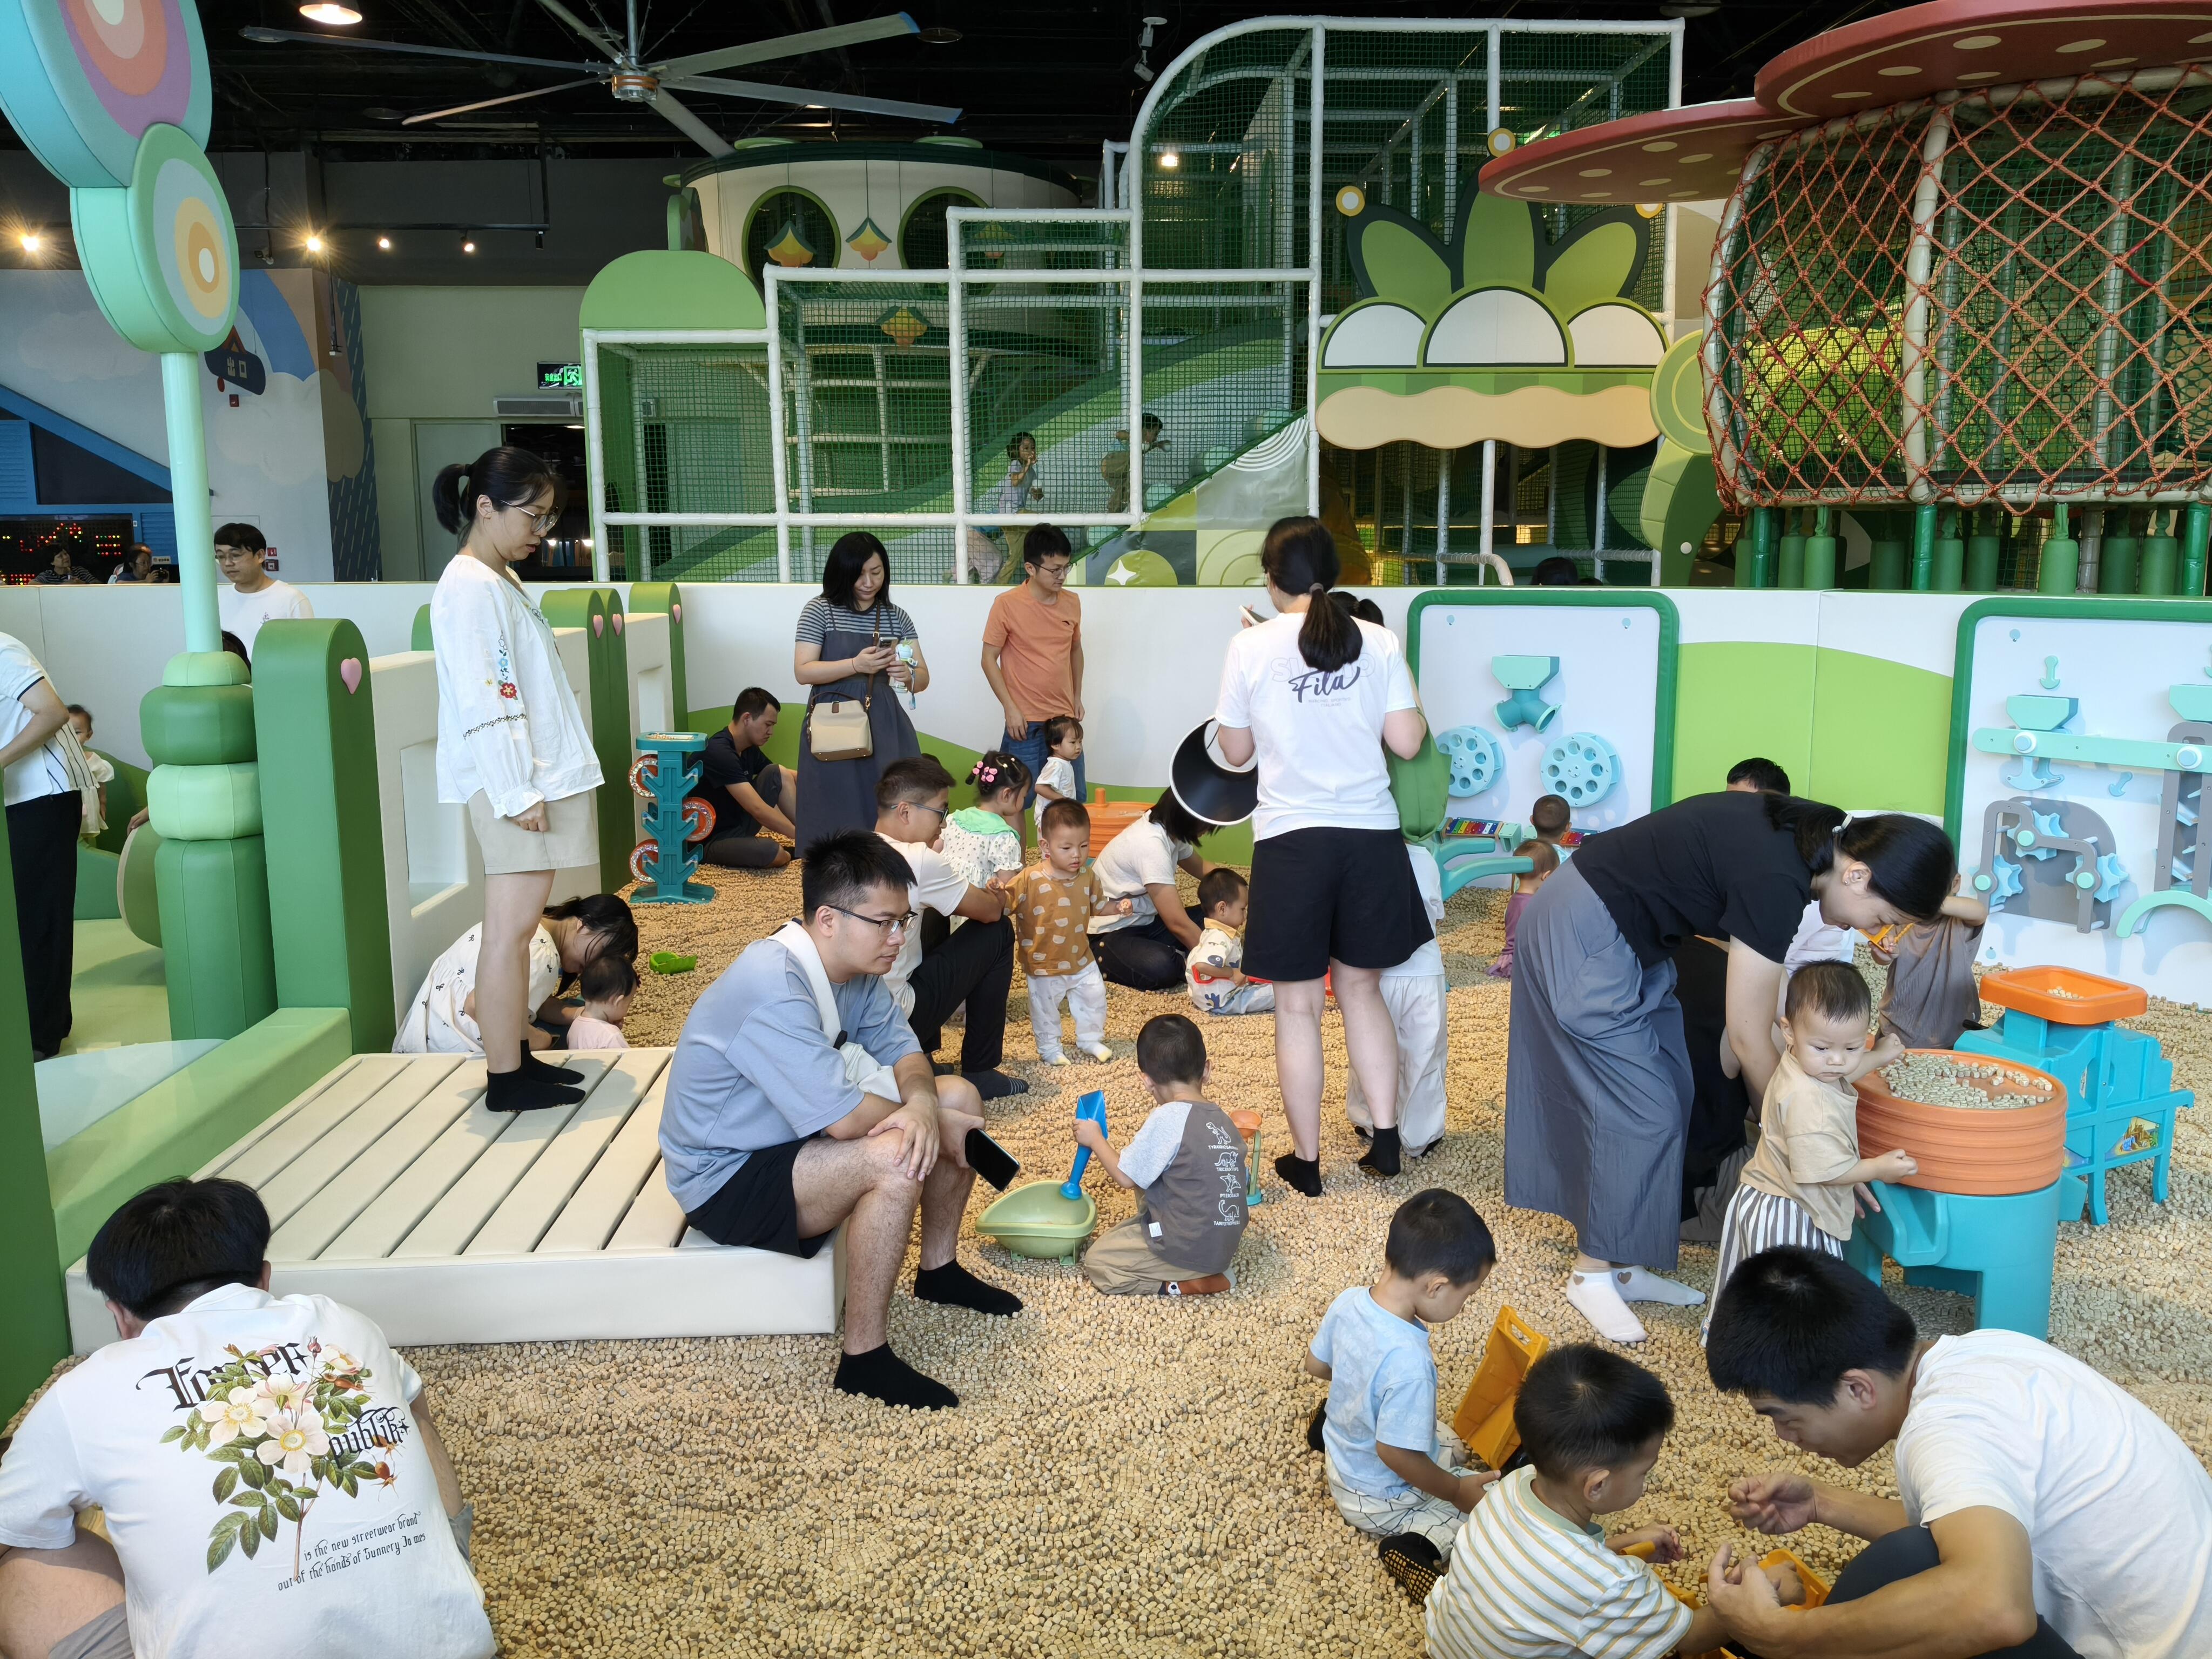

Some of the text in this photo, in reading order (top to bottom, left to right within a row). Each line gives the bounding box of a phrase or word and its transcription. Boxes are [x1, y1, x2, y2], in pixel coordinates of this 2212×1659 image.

[227, 356, 248, 379] 出口
[1288, 666, 1361, 703] Fila
[304, 1550, 312, 1561] is
[314, 1539, 328, 1557] the
[331, 1539, 349, 1552] new
[395, 1511, 421, 1529] brand
[278, 1577, 293, 1591] out
[309, 1561, 323, 1580] the
[324, 1553, 352, 1574] hands
[353, 1550, 361, 1564] of
